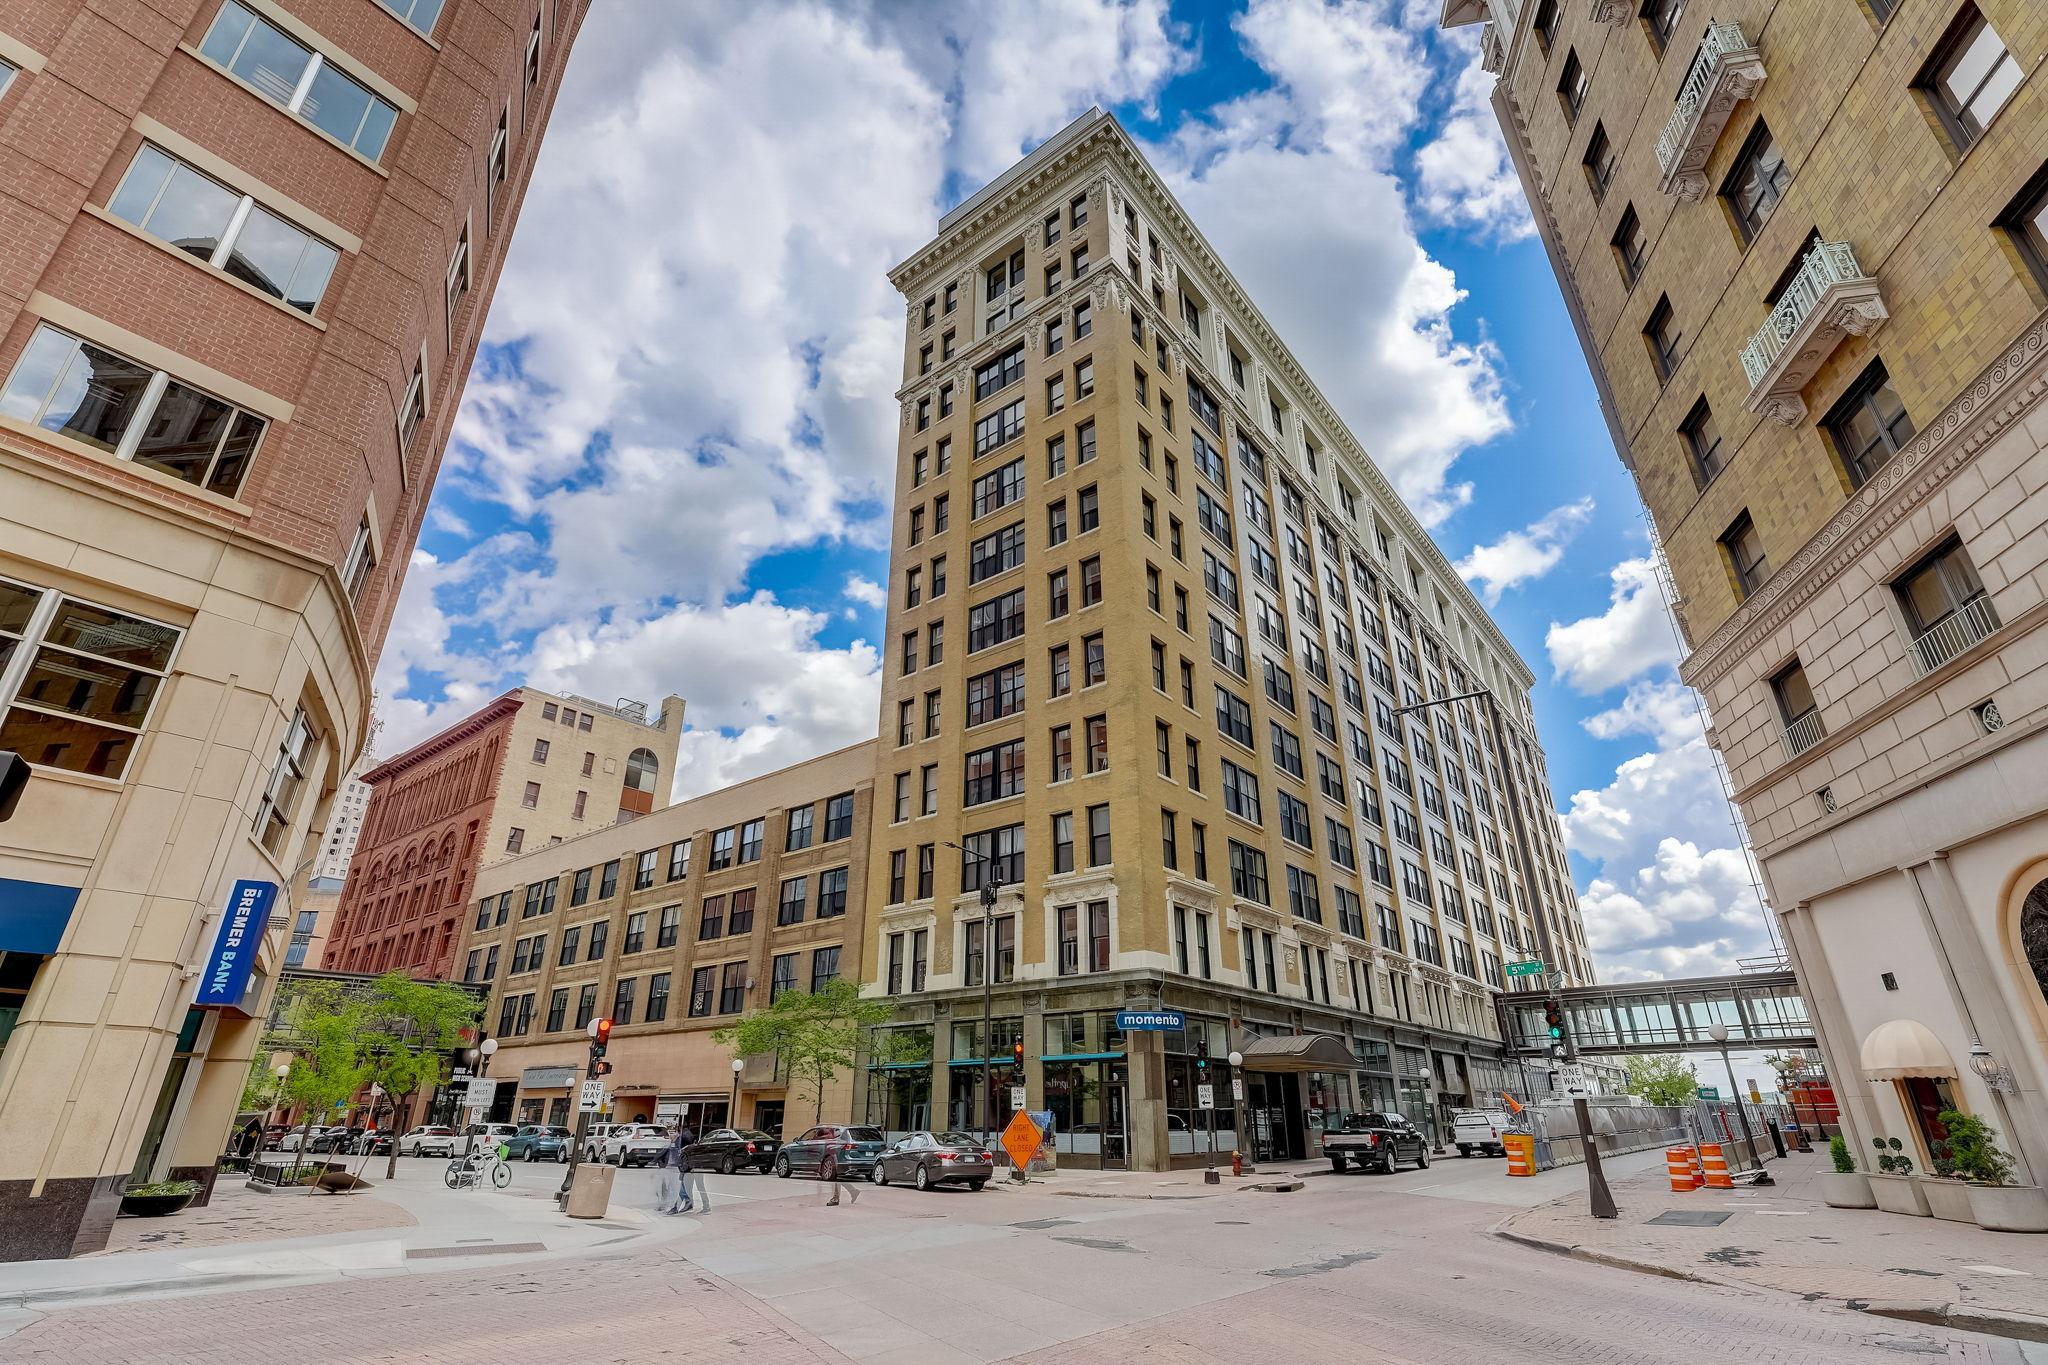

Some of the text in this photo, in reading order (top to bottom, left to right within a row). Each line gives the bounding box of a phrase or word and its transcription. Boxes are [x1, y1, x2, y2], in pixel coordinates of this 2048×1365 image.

[210, 888, 257, 994] BREMER BANK
[1512, 966, 1525, 974] 5TH
[1124, 1014, 1180, 1026] momento
[1561, 1067, 1581, 1077] ONE
[1562, 1077, 1582, 1085] WAY
[584, 1082, 602, 1091] ONE
[582, 1091, 601, 1099] WAY
